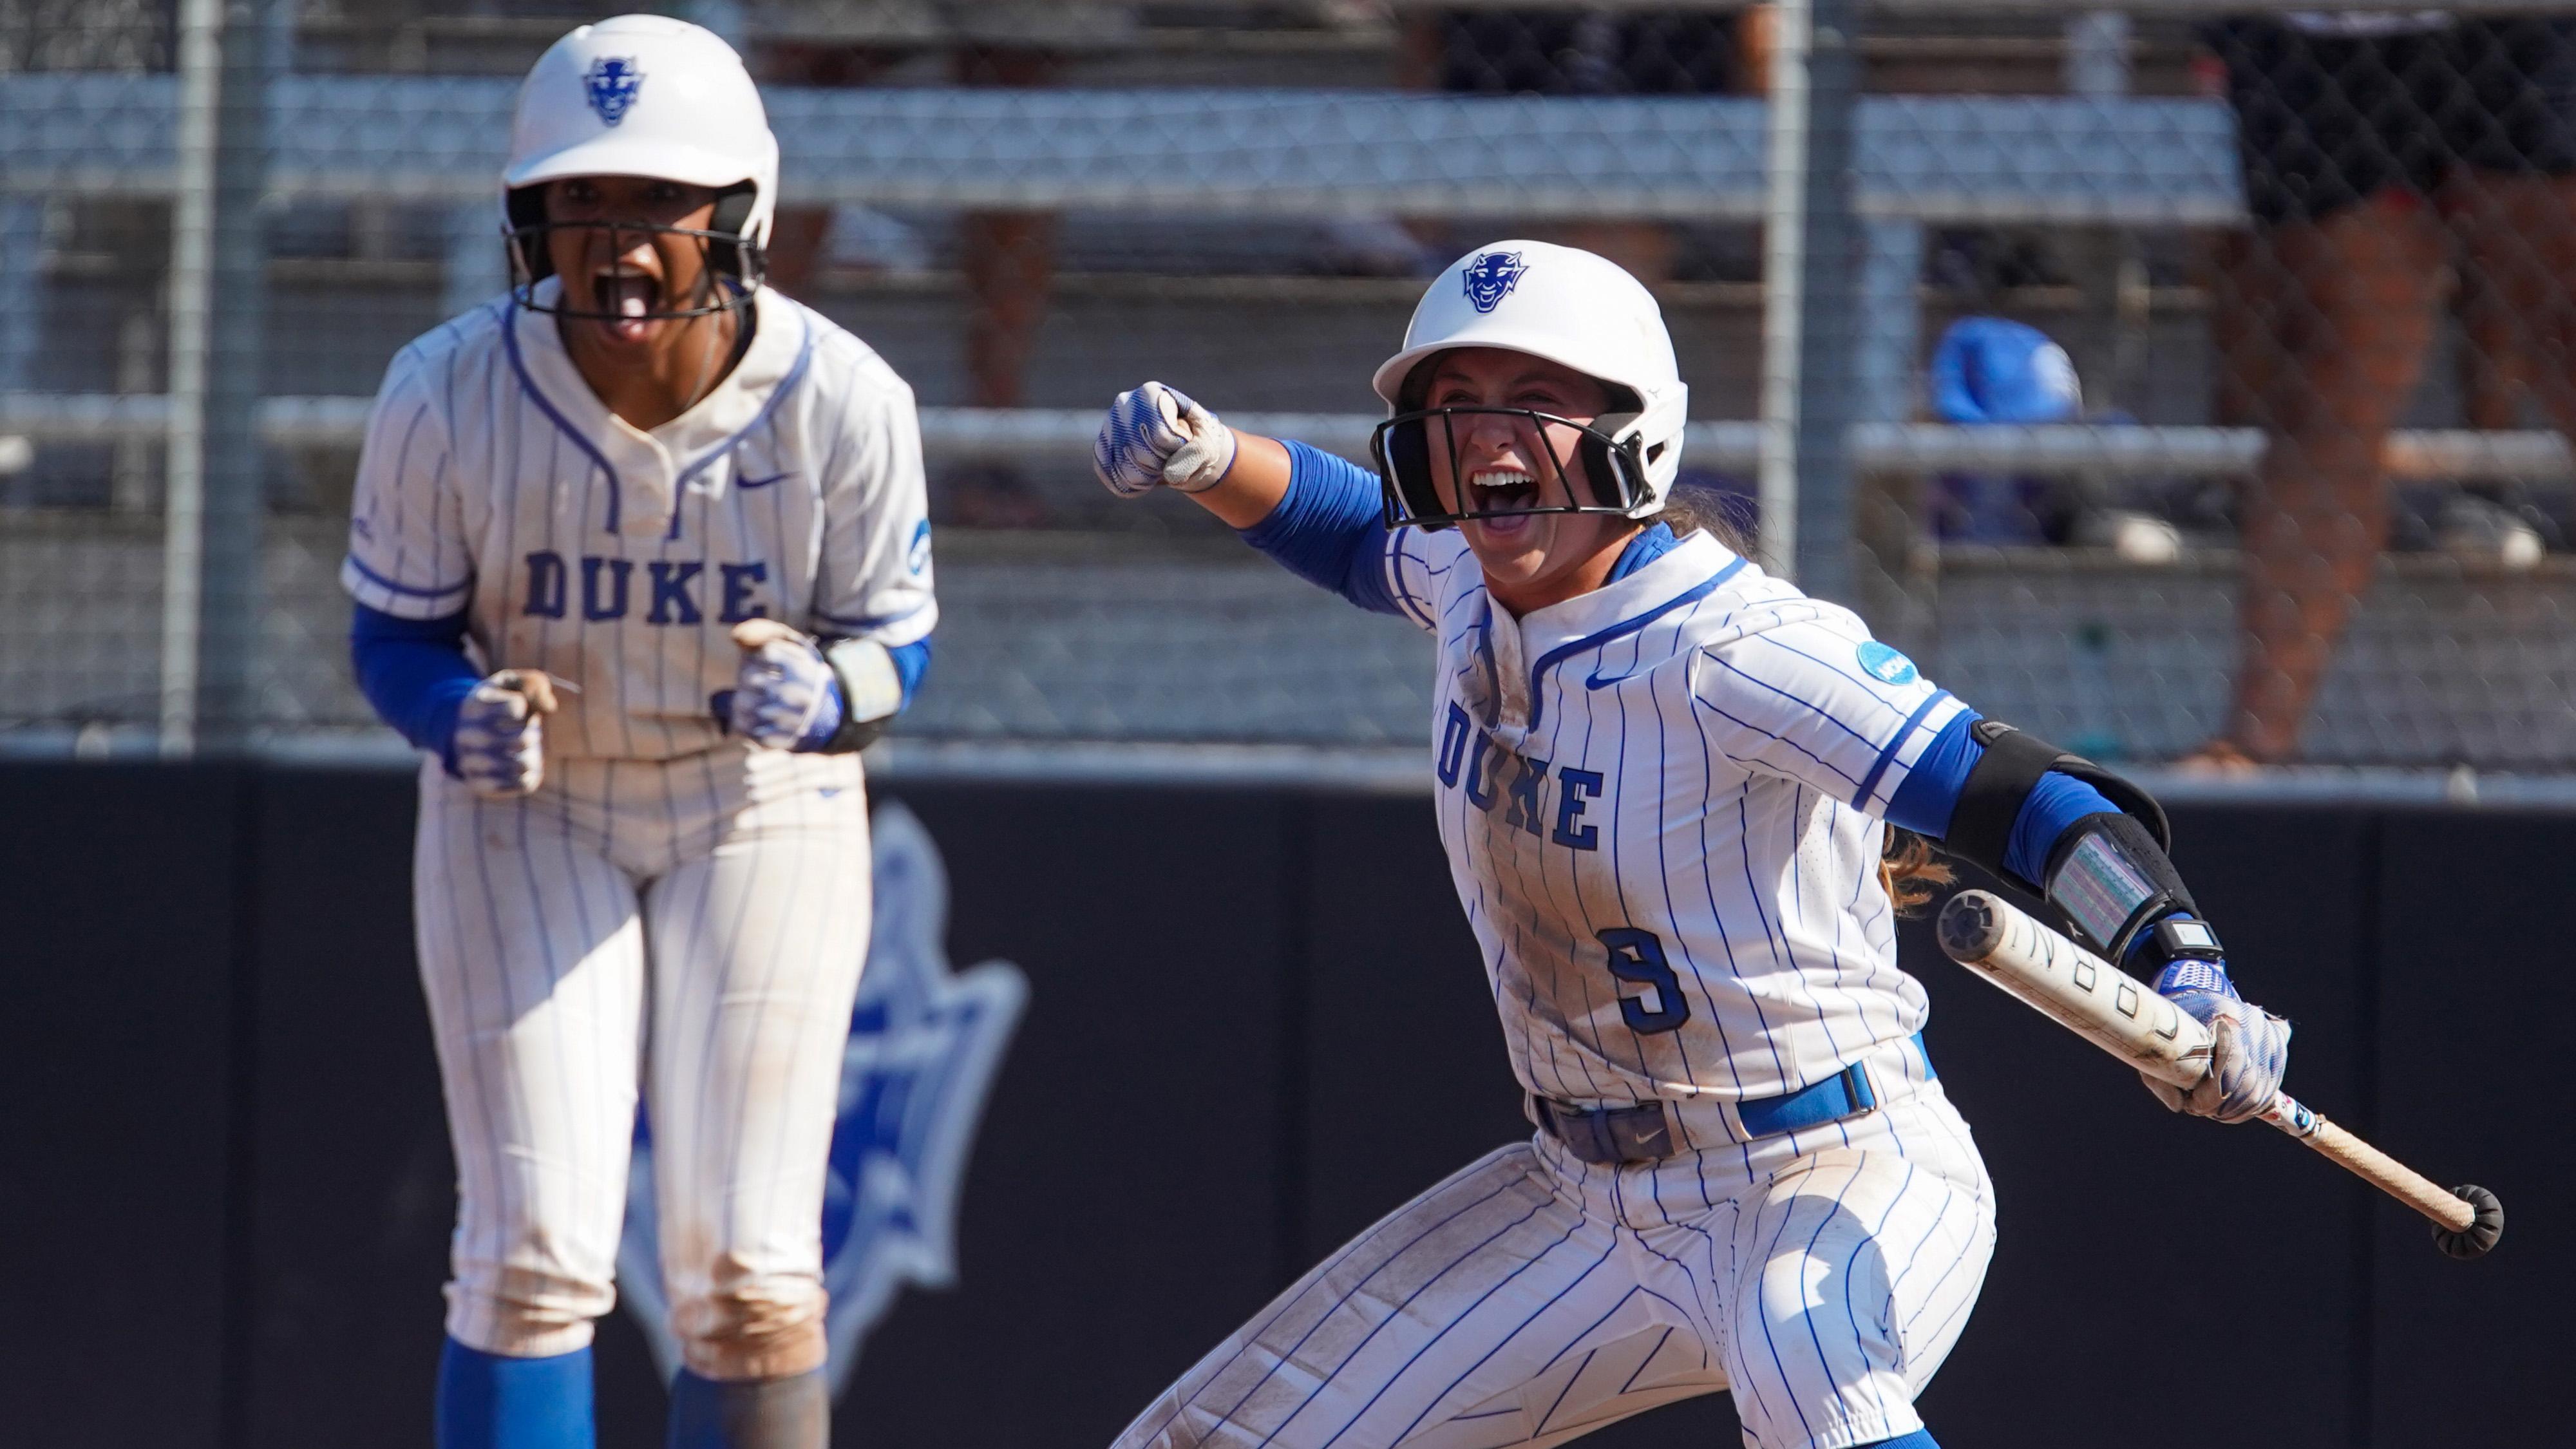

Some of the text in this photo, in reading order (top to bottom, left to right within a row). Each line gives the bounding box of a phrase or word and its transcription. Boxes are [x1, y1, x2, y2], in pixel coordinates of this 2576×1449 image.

[524, 550, 768, 624] DUKE
[1437, 699, 1604, 851] DUKE
[1595, 927, 1691, 1036] 9
